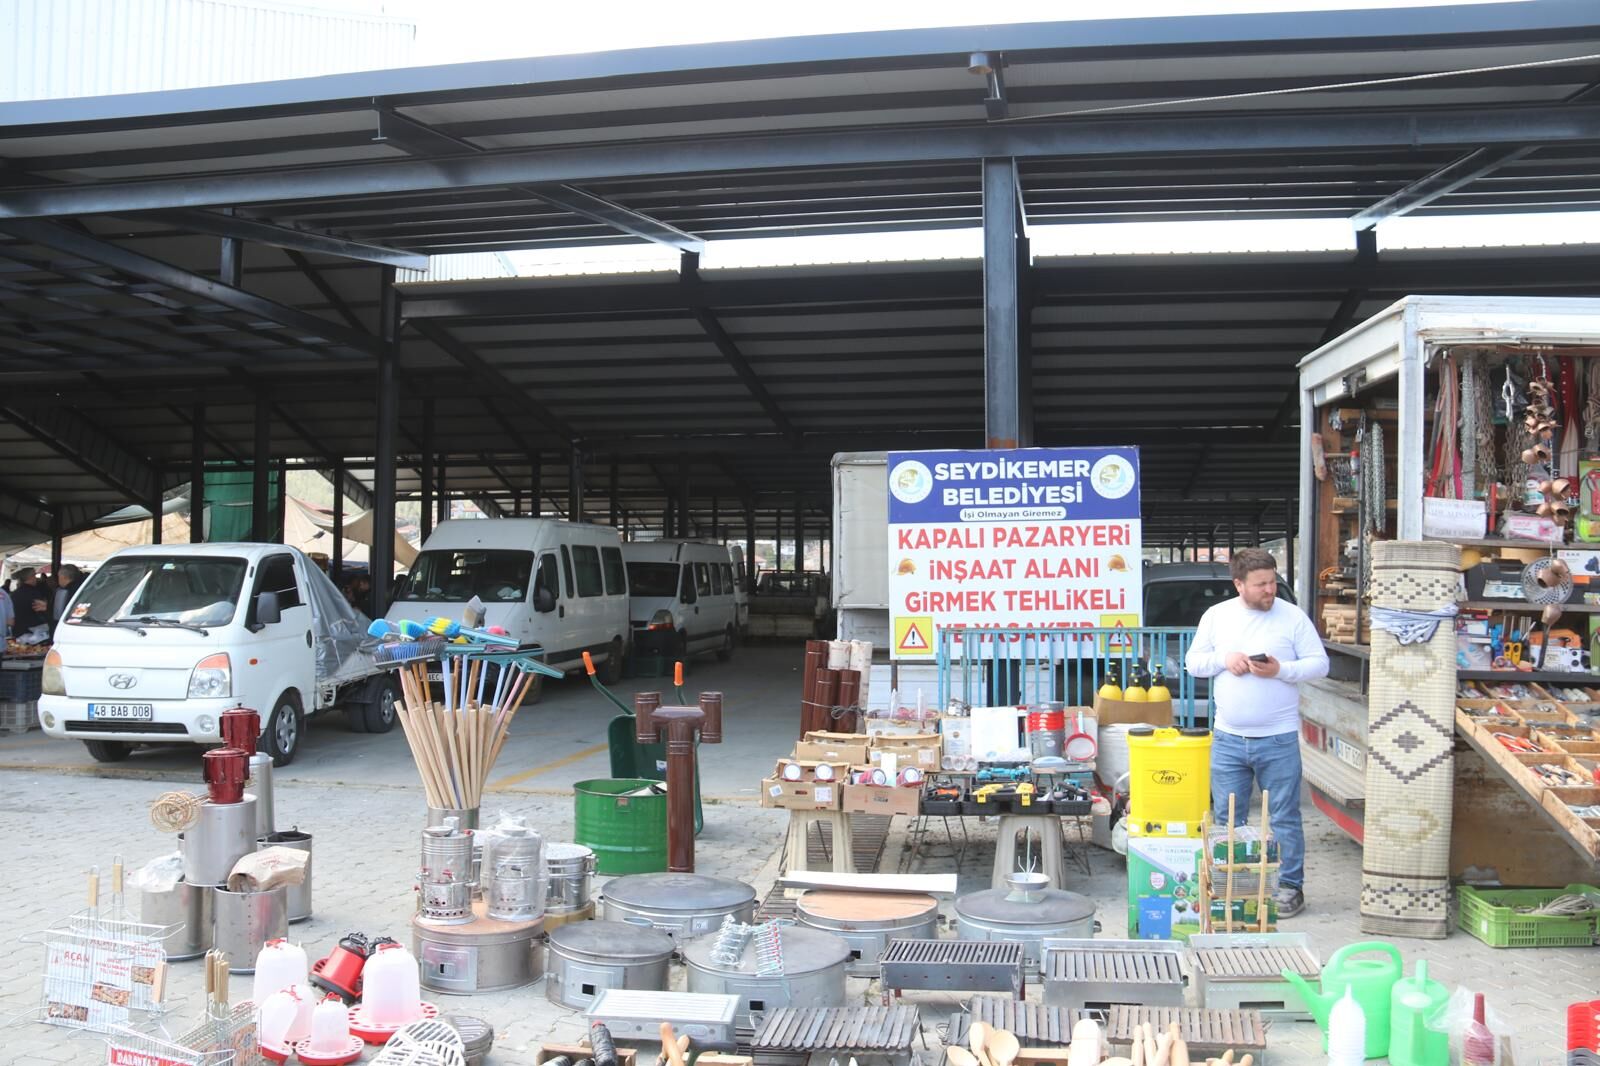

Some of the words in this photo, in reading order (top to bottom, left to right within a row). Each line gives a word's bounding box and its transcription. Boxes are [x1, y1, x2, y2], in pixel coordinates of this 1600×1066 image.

[934, 457, 1090, 481] SEYDİKEMER
[943, 481, 1083, 506] BELEDİYESİ
[964, 510, 975, 519] İşi
[977, 510, 1020, 519] Olmayan
[1022, 509, 1062, 517] Giremez
[898, 528, 984, 549] KAPALI
[993, 524, 1130, 548] PAZARYERİ
[929, 559, 1017, 584] İNŞAAT
[1024, 558, 1098, 578] ALANI
[905, 591, 996, 612] GİRMEK
[1003, 588, 1125, 611] TEHLİKELİ
[95, 705, 106, 716] 48
[111, 705, 128, 716] BAB
[132, 706, 150, 717] 008
